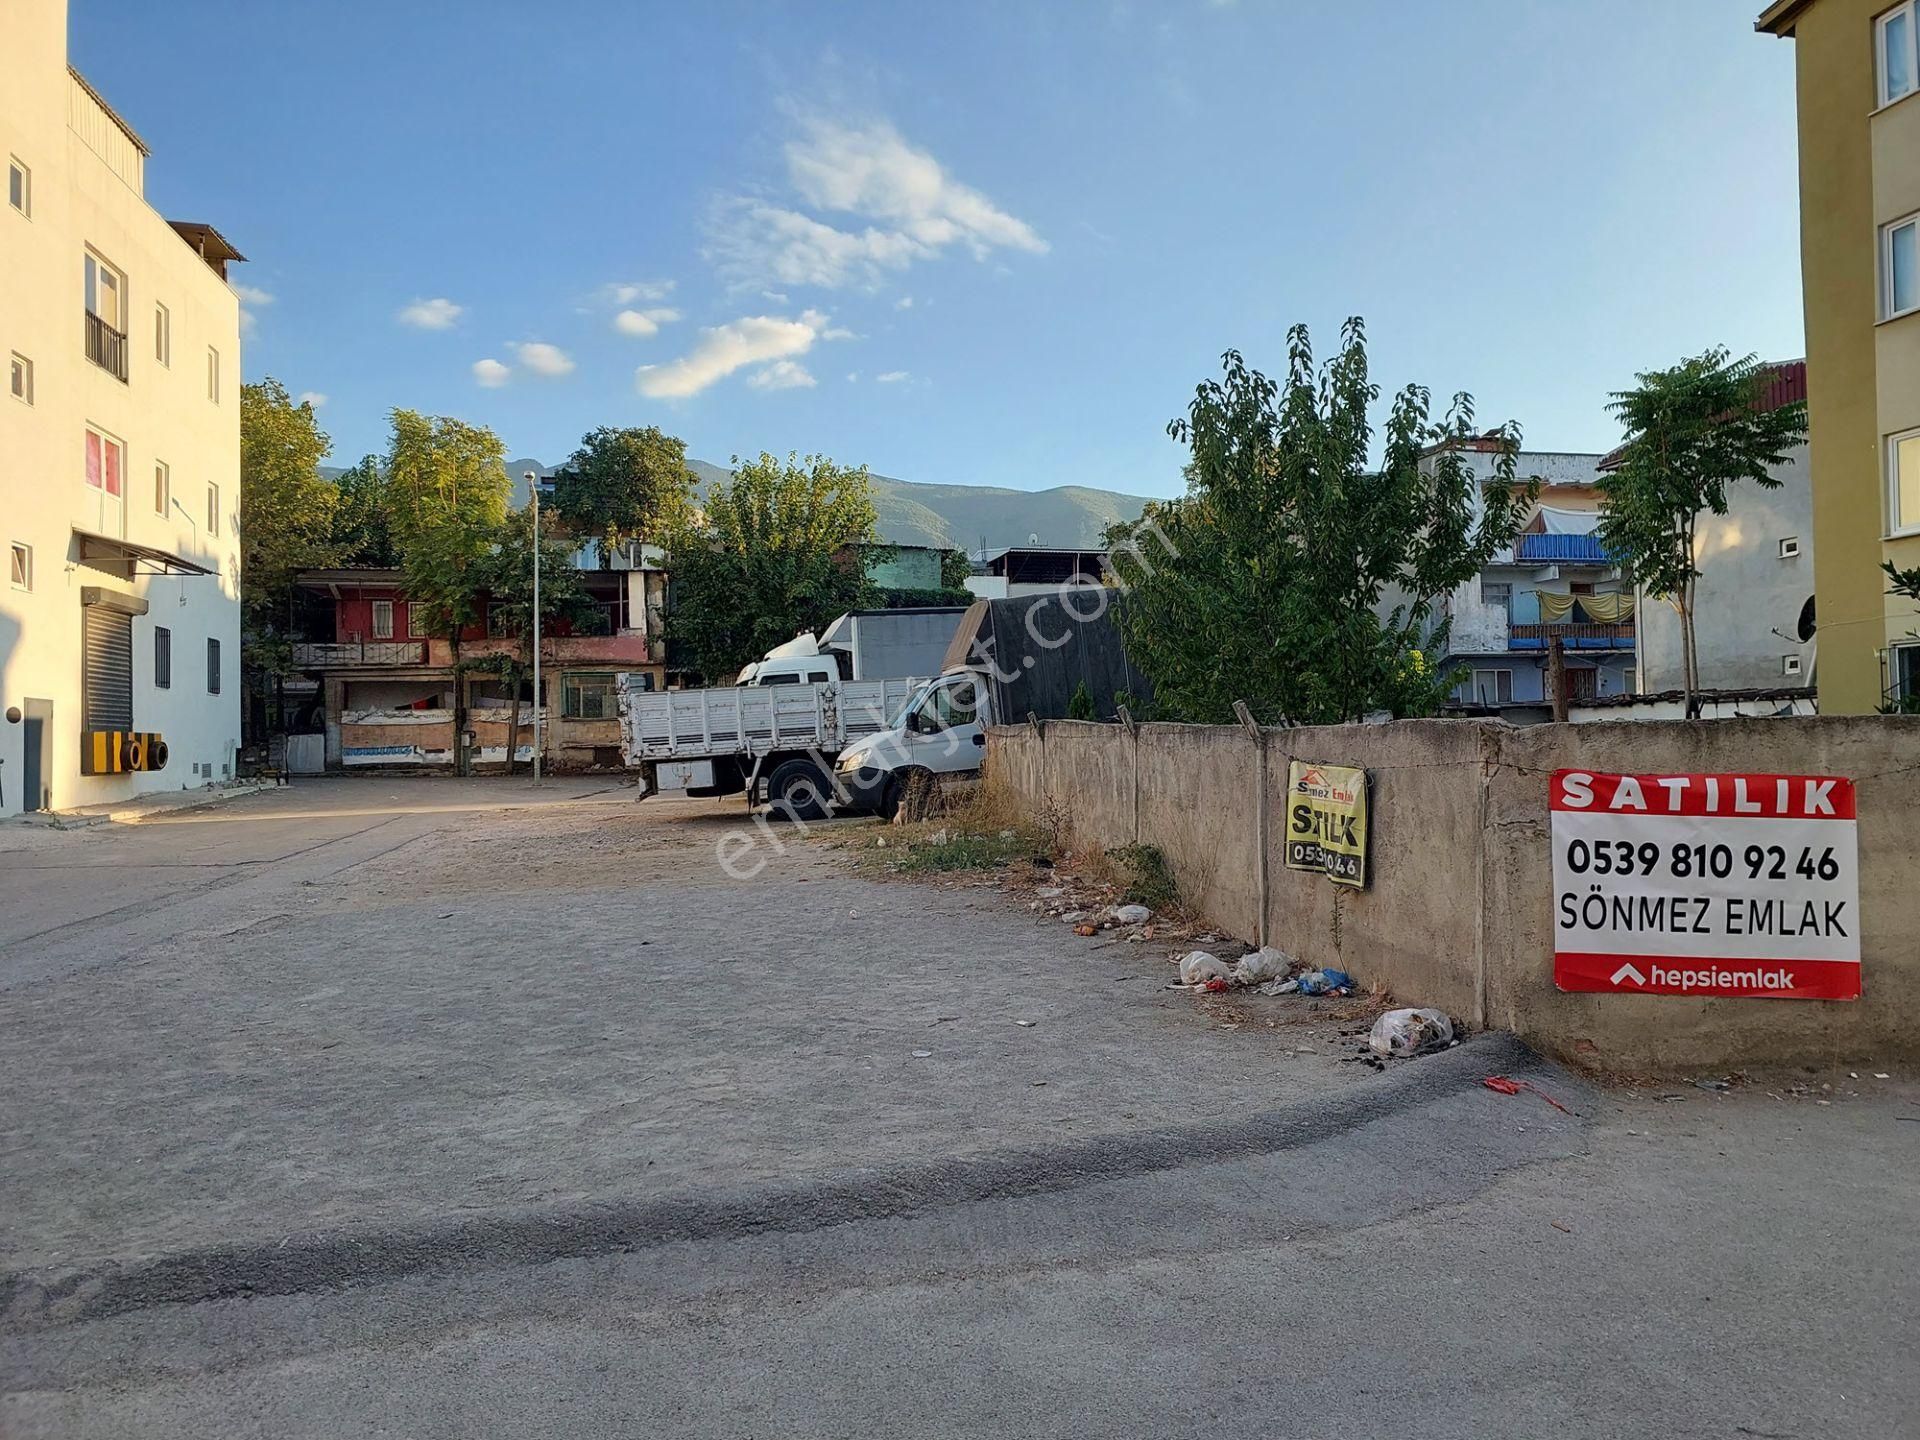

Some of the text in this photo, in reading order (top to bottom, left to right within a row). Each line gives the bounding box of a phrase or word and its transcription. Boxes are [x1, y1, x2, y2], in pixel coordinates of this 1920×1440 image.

[1561, 772, 1837, 815] SATILIK
[1567, 838, 1840, 881] 0539 810 92 46
[1560, 883, 1849, 938] SÖNMEZ EMLAK
[1651, 964, 1795, 991] hepsiemlak
